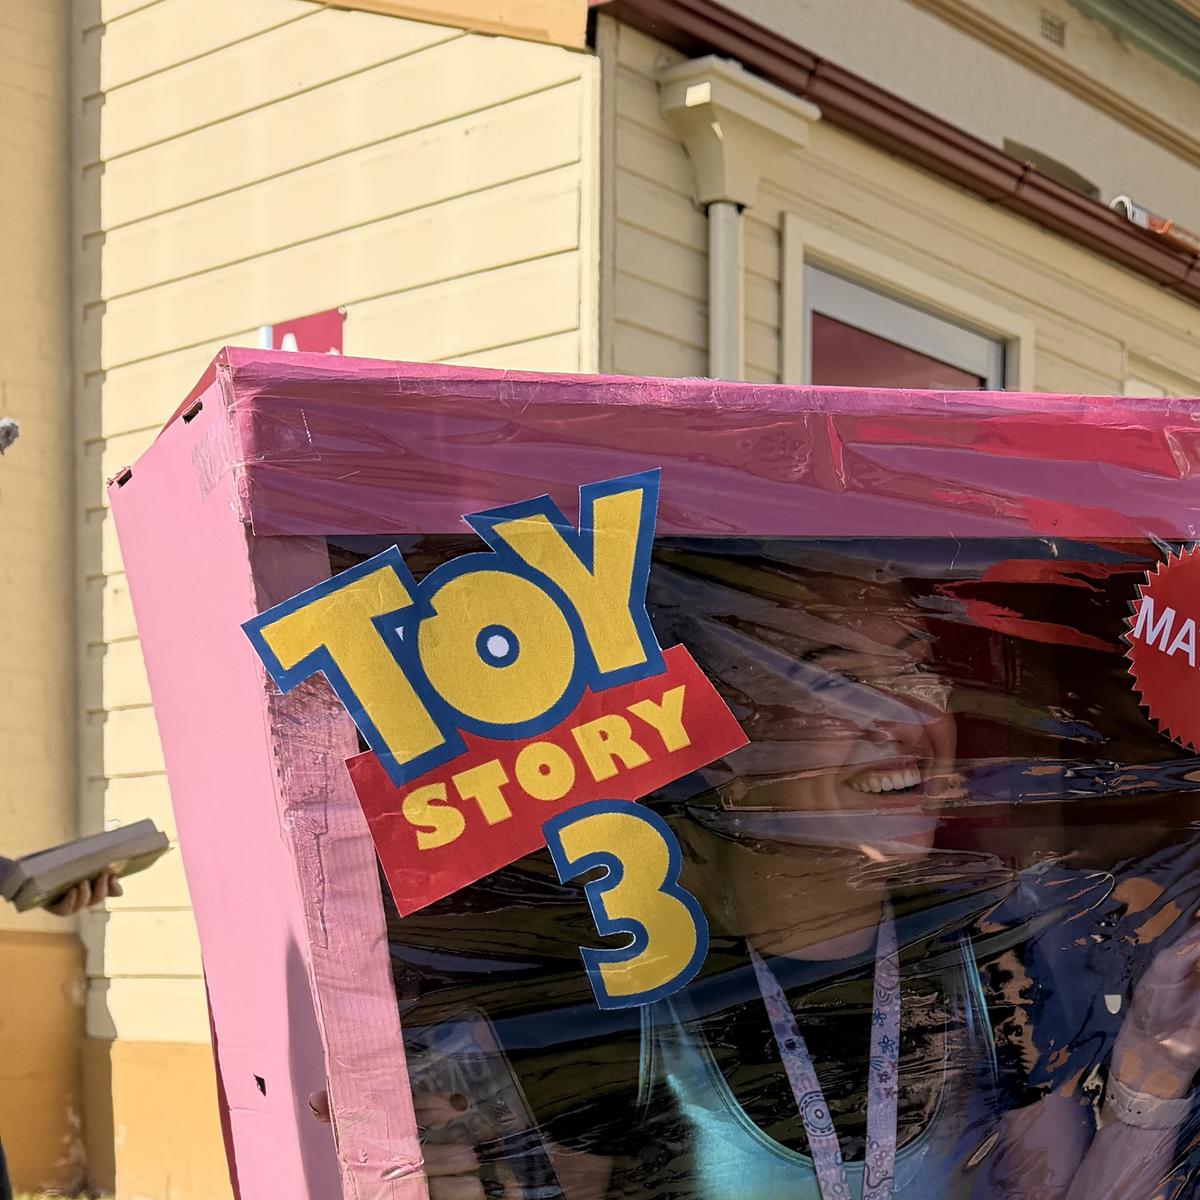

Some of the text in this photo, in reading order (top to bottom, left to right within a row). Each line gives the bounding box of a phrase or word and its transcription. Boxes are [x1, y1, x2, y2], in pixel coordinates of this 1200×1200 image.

[256, 484, 647, 768] TOY
[400, 683, 693, 852] STORY
[557, 810, 699, 998] 3
